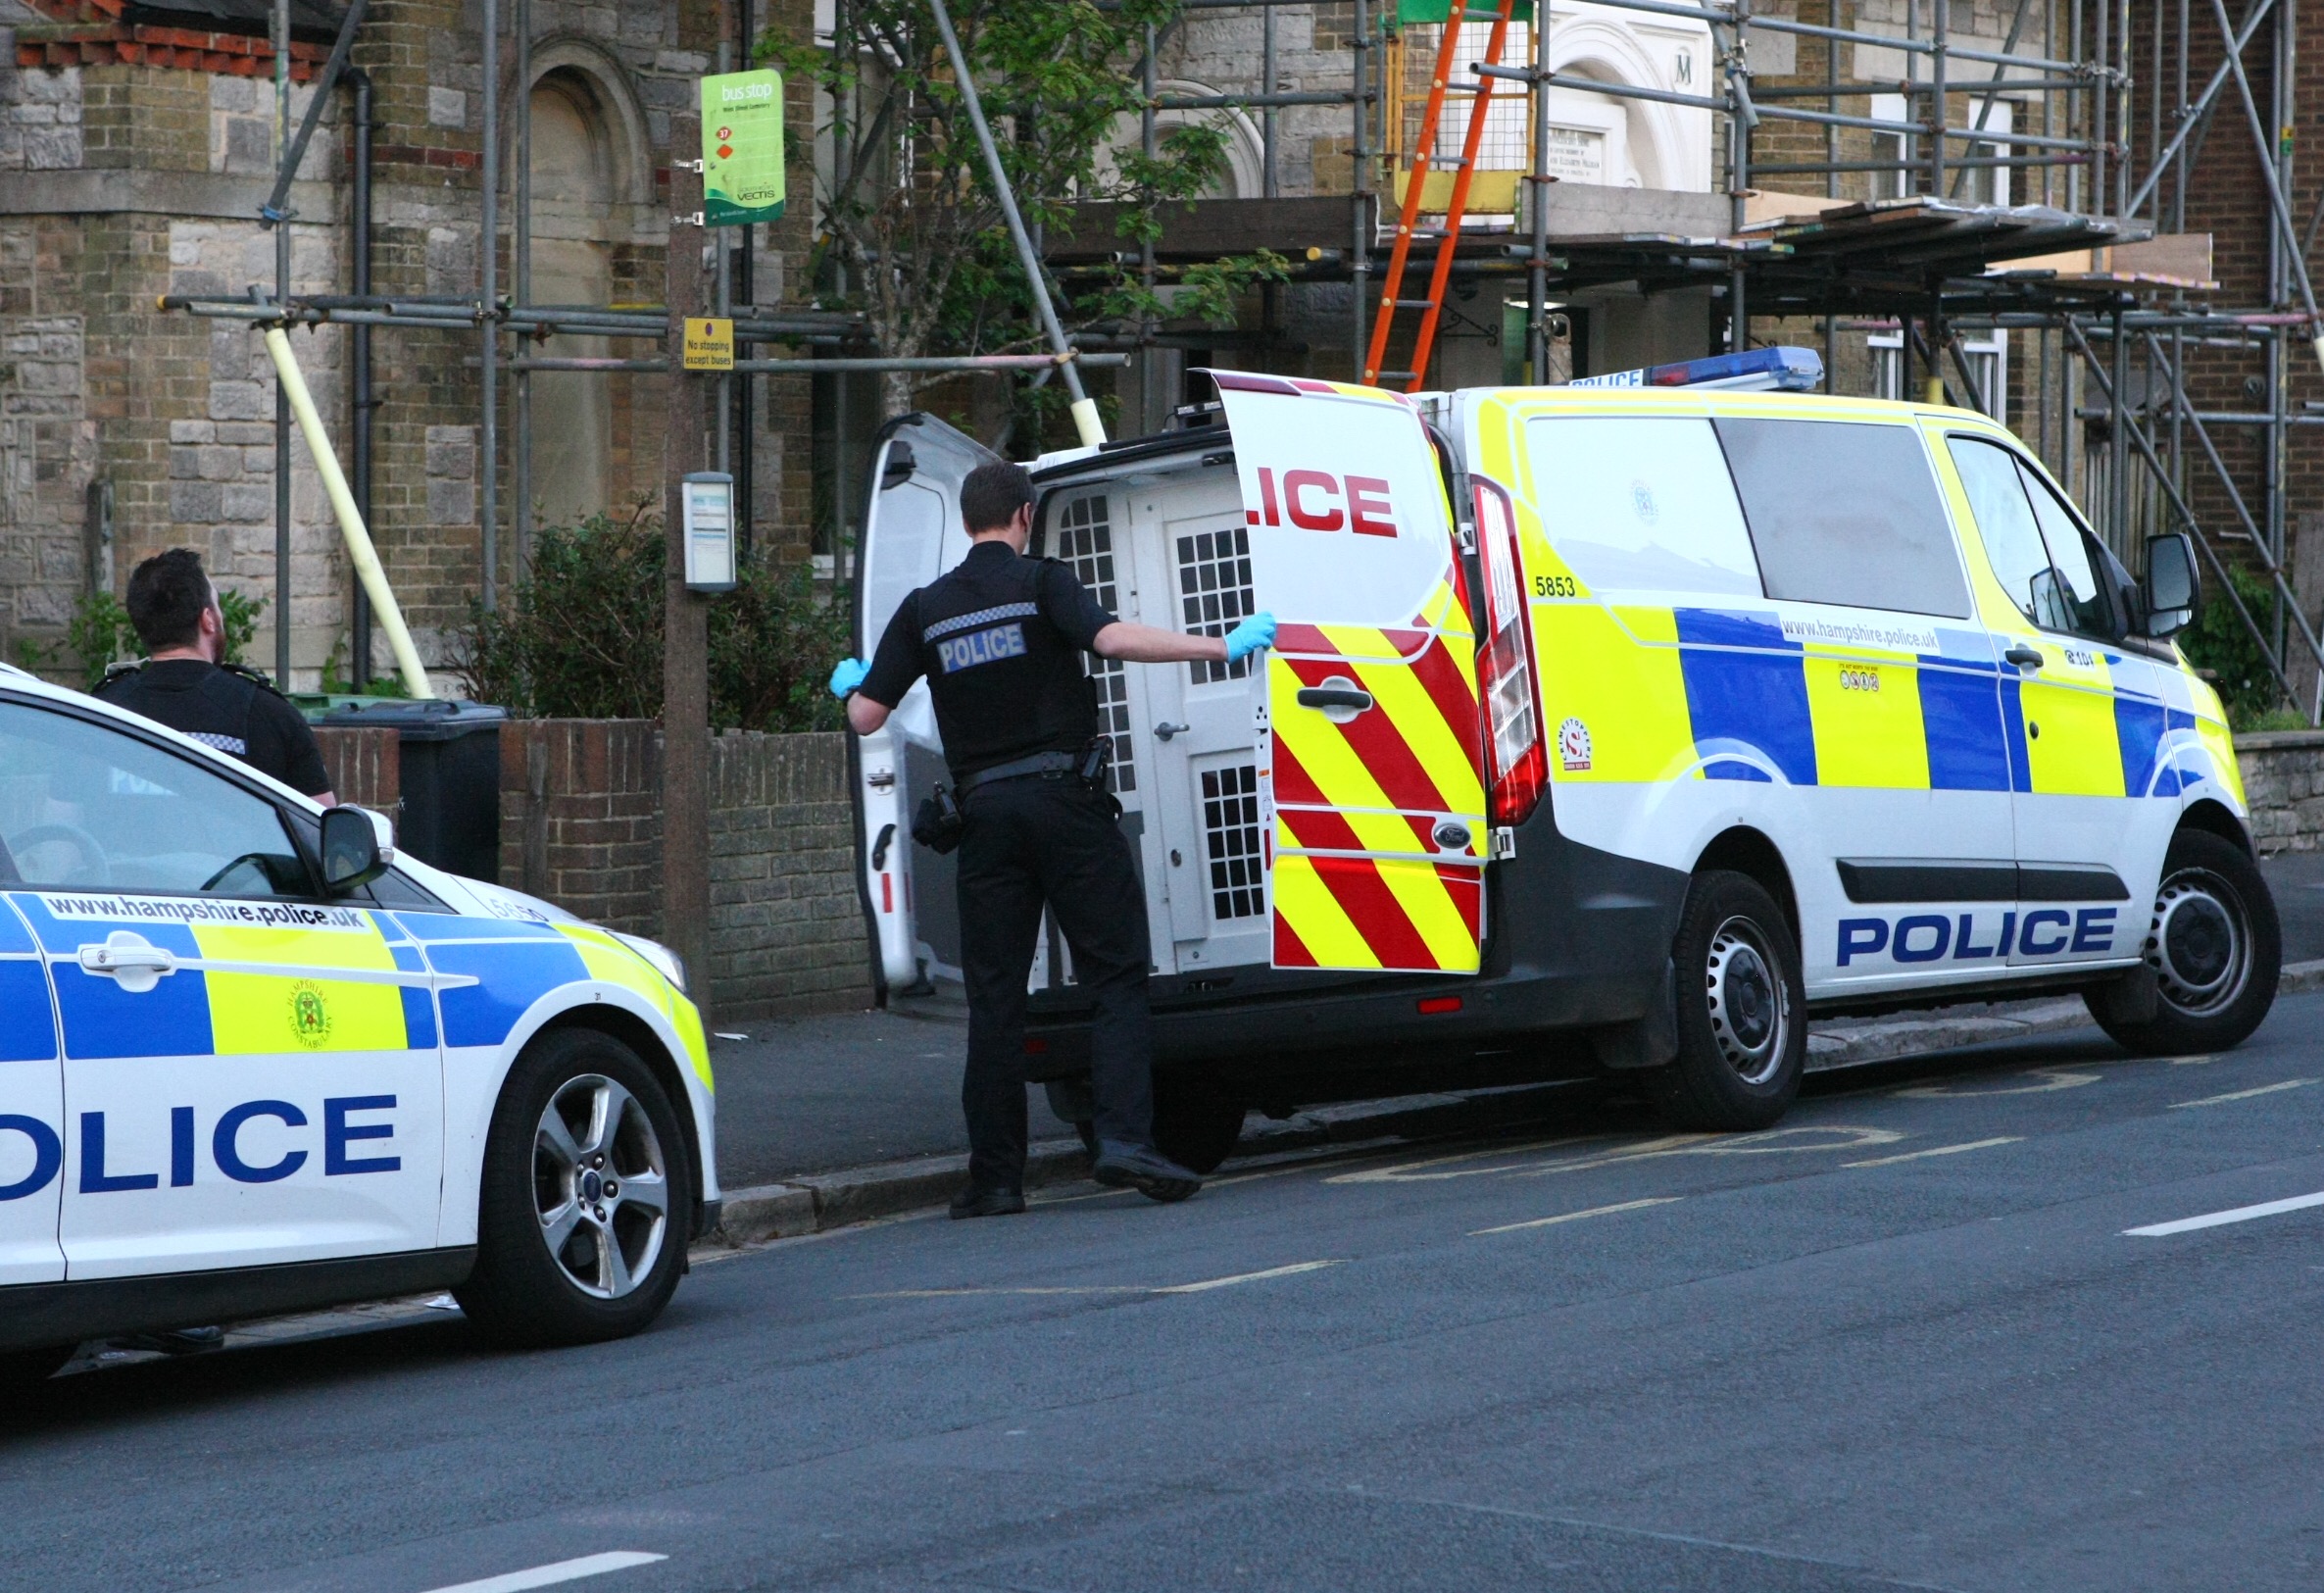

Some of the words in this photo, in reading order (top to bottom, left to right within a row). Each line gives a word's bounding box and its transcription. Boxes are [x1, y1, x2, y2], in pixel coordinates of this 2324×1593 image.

[1675, 54, 1692, 84] M
[721, 84, 744, 102] bus
[745, 83, 771, 101] stop
[719, 128, 729, 138] 37
[737, 190, 775, 201] VECTIS
[688, 339, 698, 350] No
[699, 340, 729, 353] stopping
[685, 354, 710, 367] except
[711, 354, 731, 366] buses
[1246, 467, 1399, 538] ICE
[1536, 576, 1575, 597] 5853
[940, 623, 1023, 673] POLICE
[1782, 620, 1938, 649] www.hampshire.police.uk
[47, 896, 366, 928] www.hampshire.police.uk
[1836, 908, 2117, 967] POLICE
[287, 979, 328, 1007] HAMPSHIRE
[288, 1015, 331, 1049] CONSTABULARY
